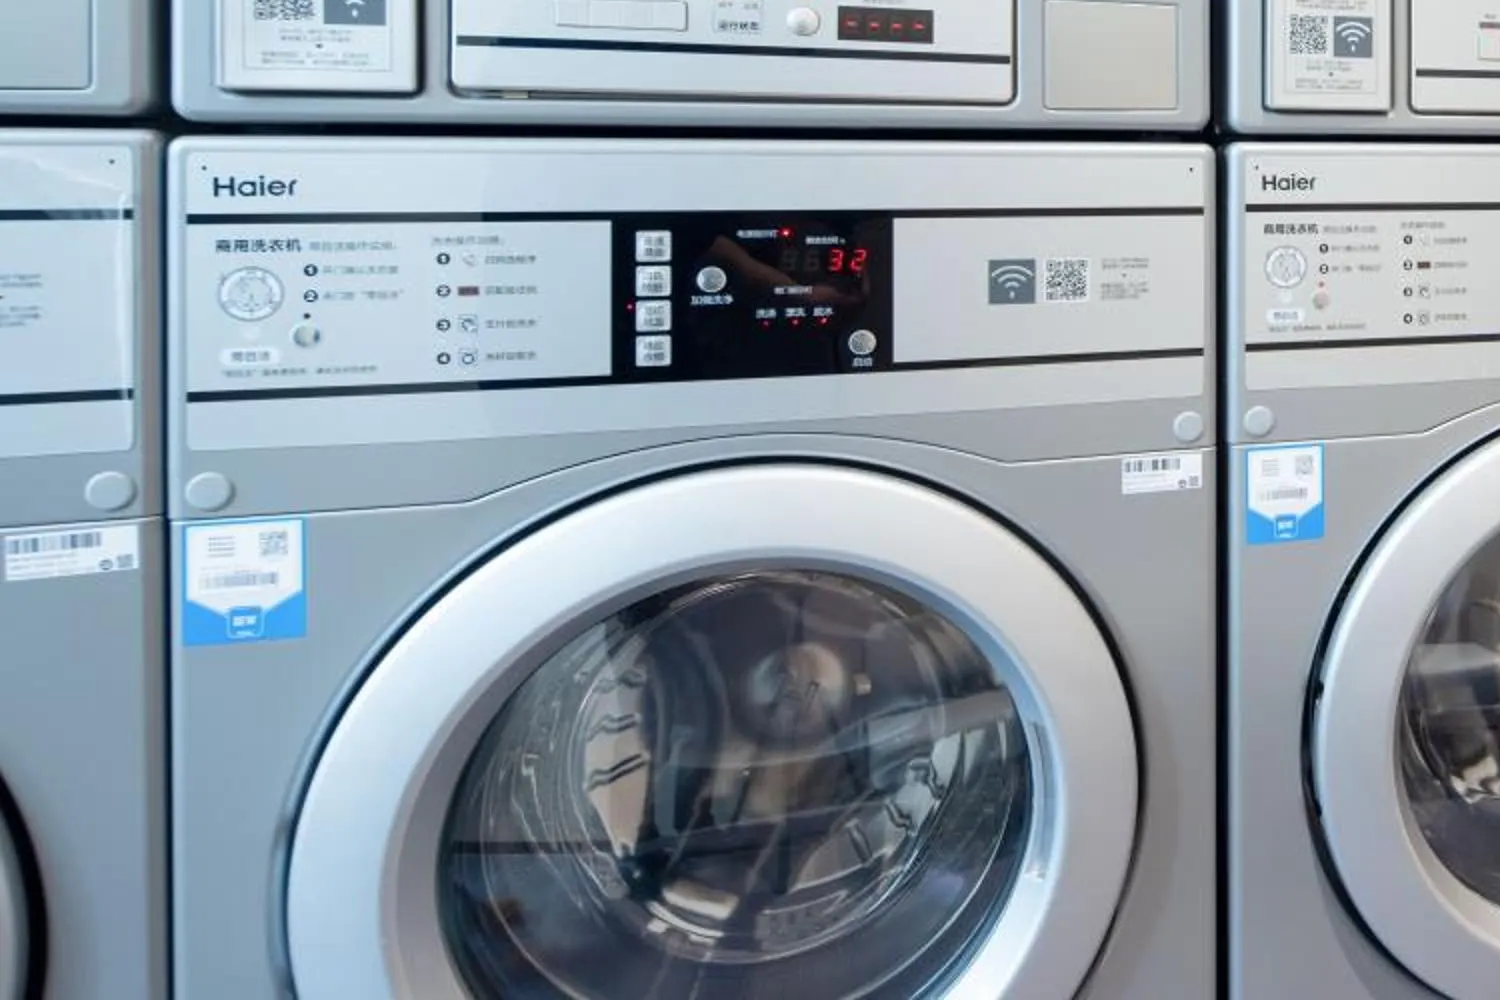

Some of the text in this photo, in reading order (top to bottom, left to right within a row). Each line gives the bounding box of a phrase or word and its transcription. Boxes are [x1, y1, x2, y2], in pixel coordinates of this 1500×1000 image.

[212, 175, 298, 198] Haier
[1261, 174, 1316, 191] Haier
[215, 239, 302, 253] 商用洗衣机
[829, 249, 867, 271] 32
